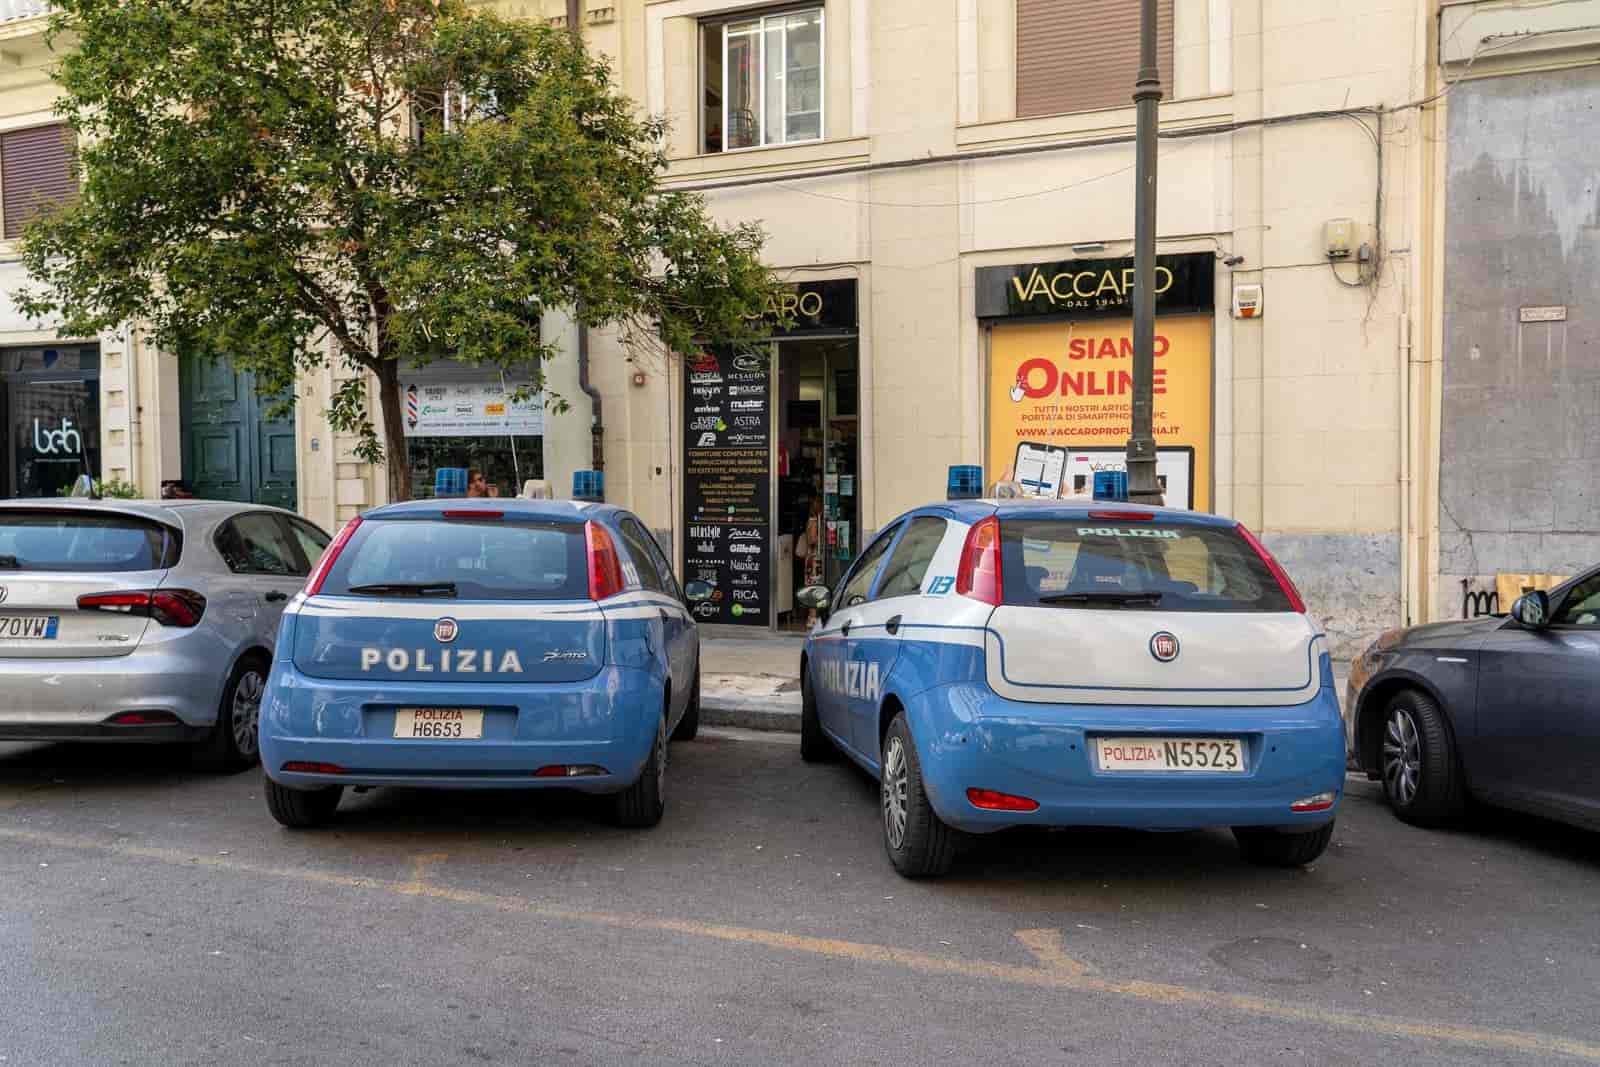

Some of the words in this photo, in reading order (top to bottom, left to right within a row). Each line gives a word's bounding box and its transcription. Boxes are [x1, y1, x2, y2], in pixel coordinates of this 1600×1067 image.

[1066, 404, 1099, 412] NOSTRI
[734, 416, 761, 425] ASTRA
[1075, 526, 1181, 539] POLIZIA
[733, 590, 760, 600] RICA
[361, 647, 524, 673] POLIZIA
[414, 709, 464, 720] POLIZIA
[412, 721, 463, 738] H6653
[1103, 746, 1157, 762] POLIZIA
[1163, 741, 1239, 768] N5523
